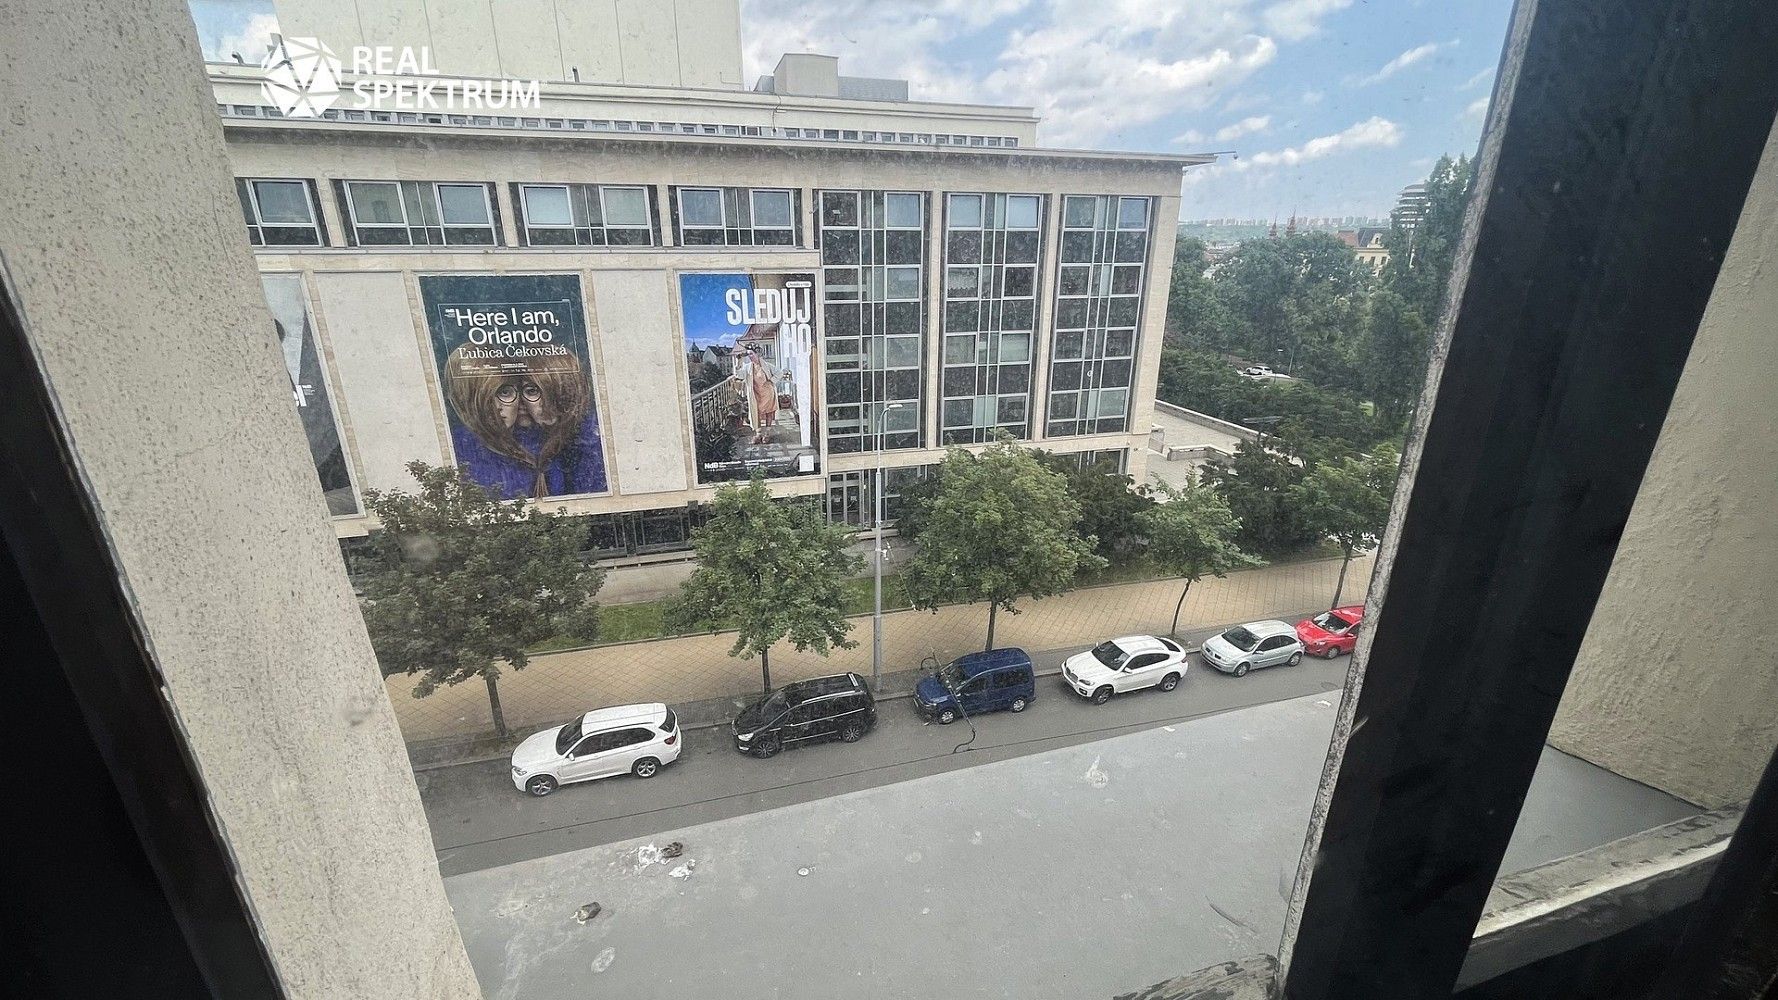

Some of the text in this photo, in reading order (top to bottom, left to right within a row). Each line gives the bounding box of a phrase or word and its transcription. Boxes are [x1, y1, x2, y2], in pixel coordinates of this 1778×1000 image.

[725, 288, 811, 325] SLEDUJ
[456, 308, 508, 327] Here
[511, 307, 518, 326] I
[522, 310, 560, 327] am,
[469, 326, 552, 345] Orlando
[505, 343, 567, 358] Čekovská
